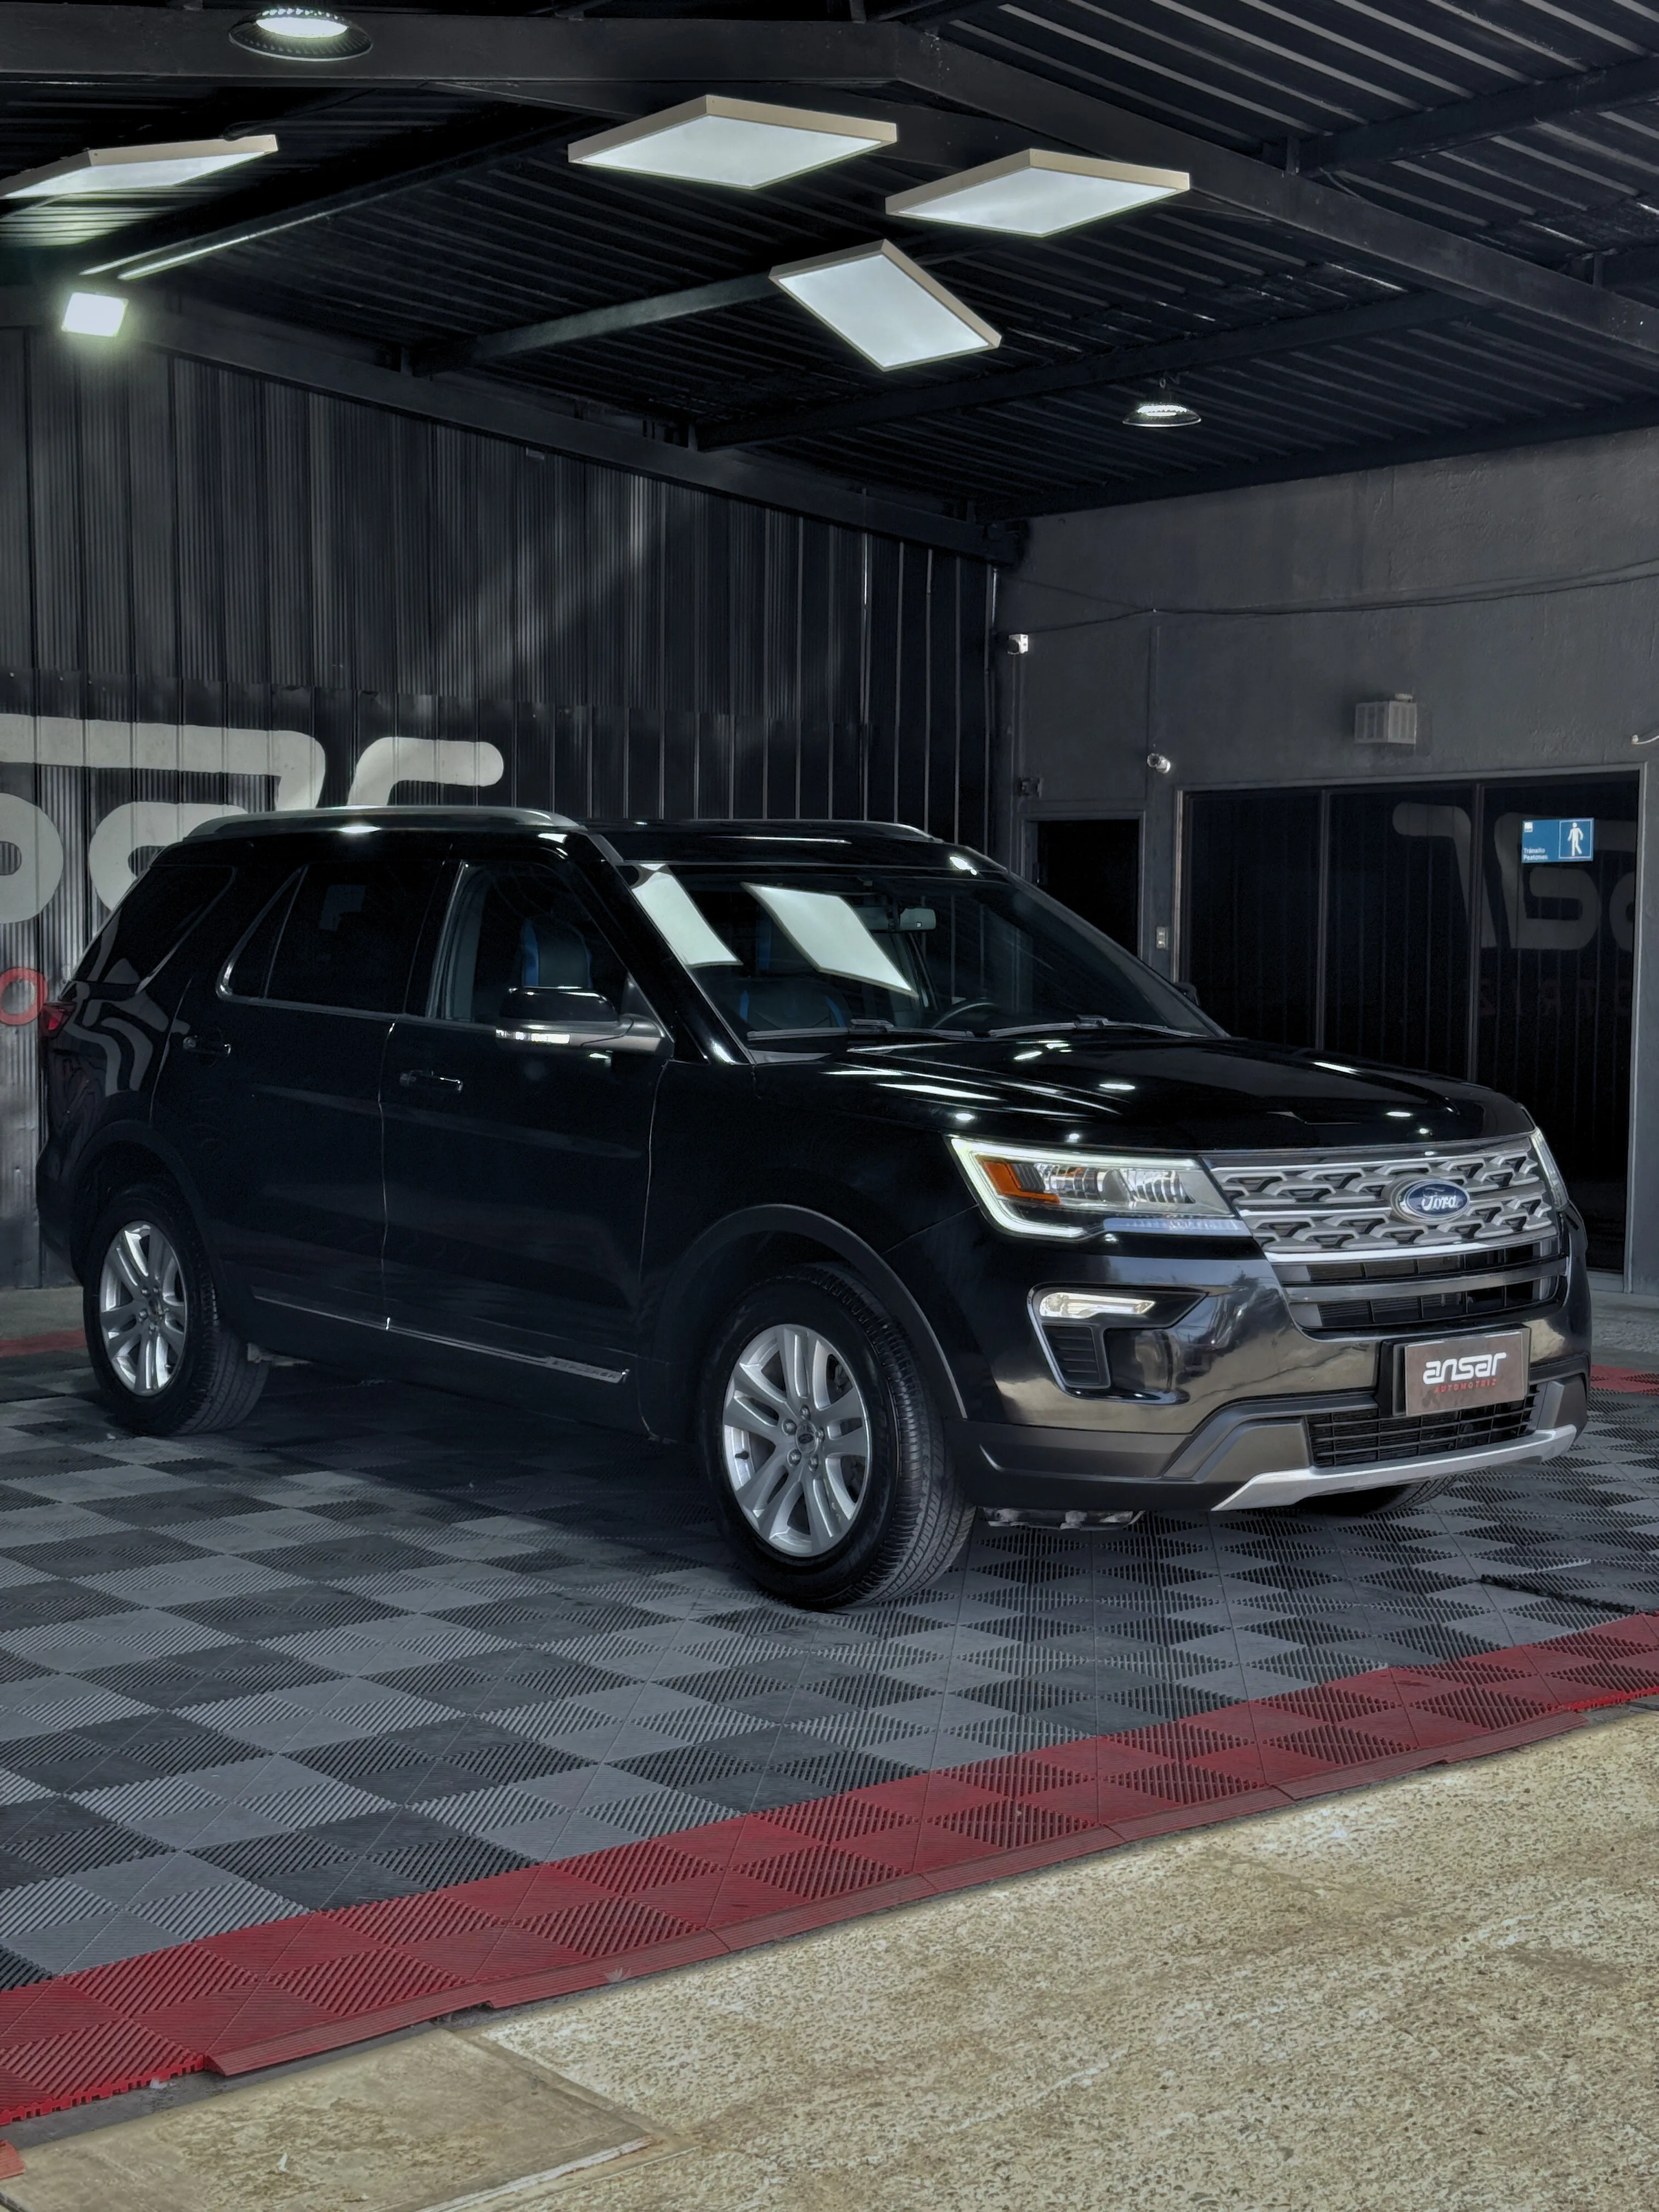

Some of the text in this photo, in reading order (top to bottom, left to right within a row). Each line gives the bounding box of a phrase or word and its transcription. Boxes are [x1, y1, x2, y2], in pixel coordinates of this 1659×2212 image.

[1421, 1187, 1457, 1211] Ford
[1423, 1352, 1507, 1385] ansar
[1434, 1378, 1498, 1394] AUTOMOTRIZ
